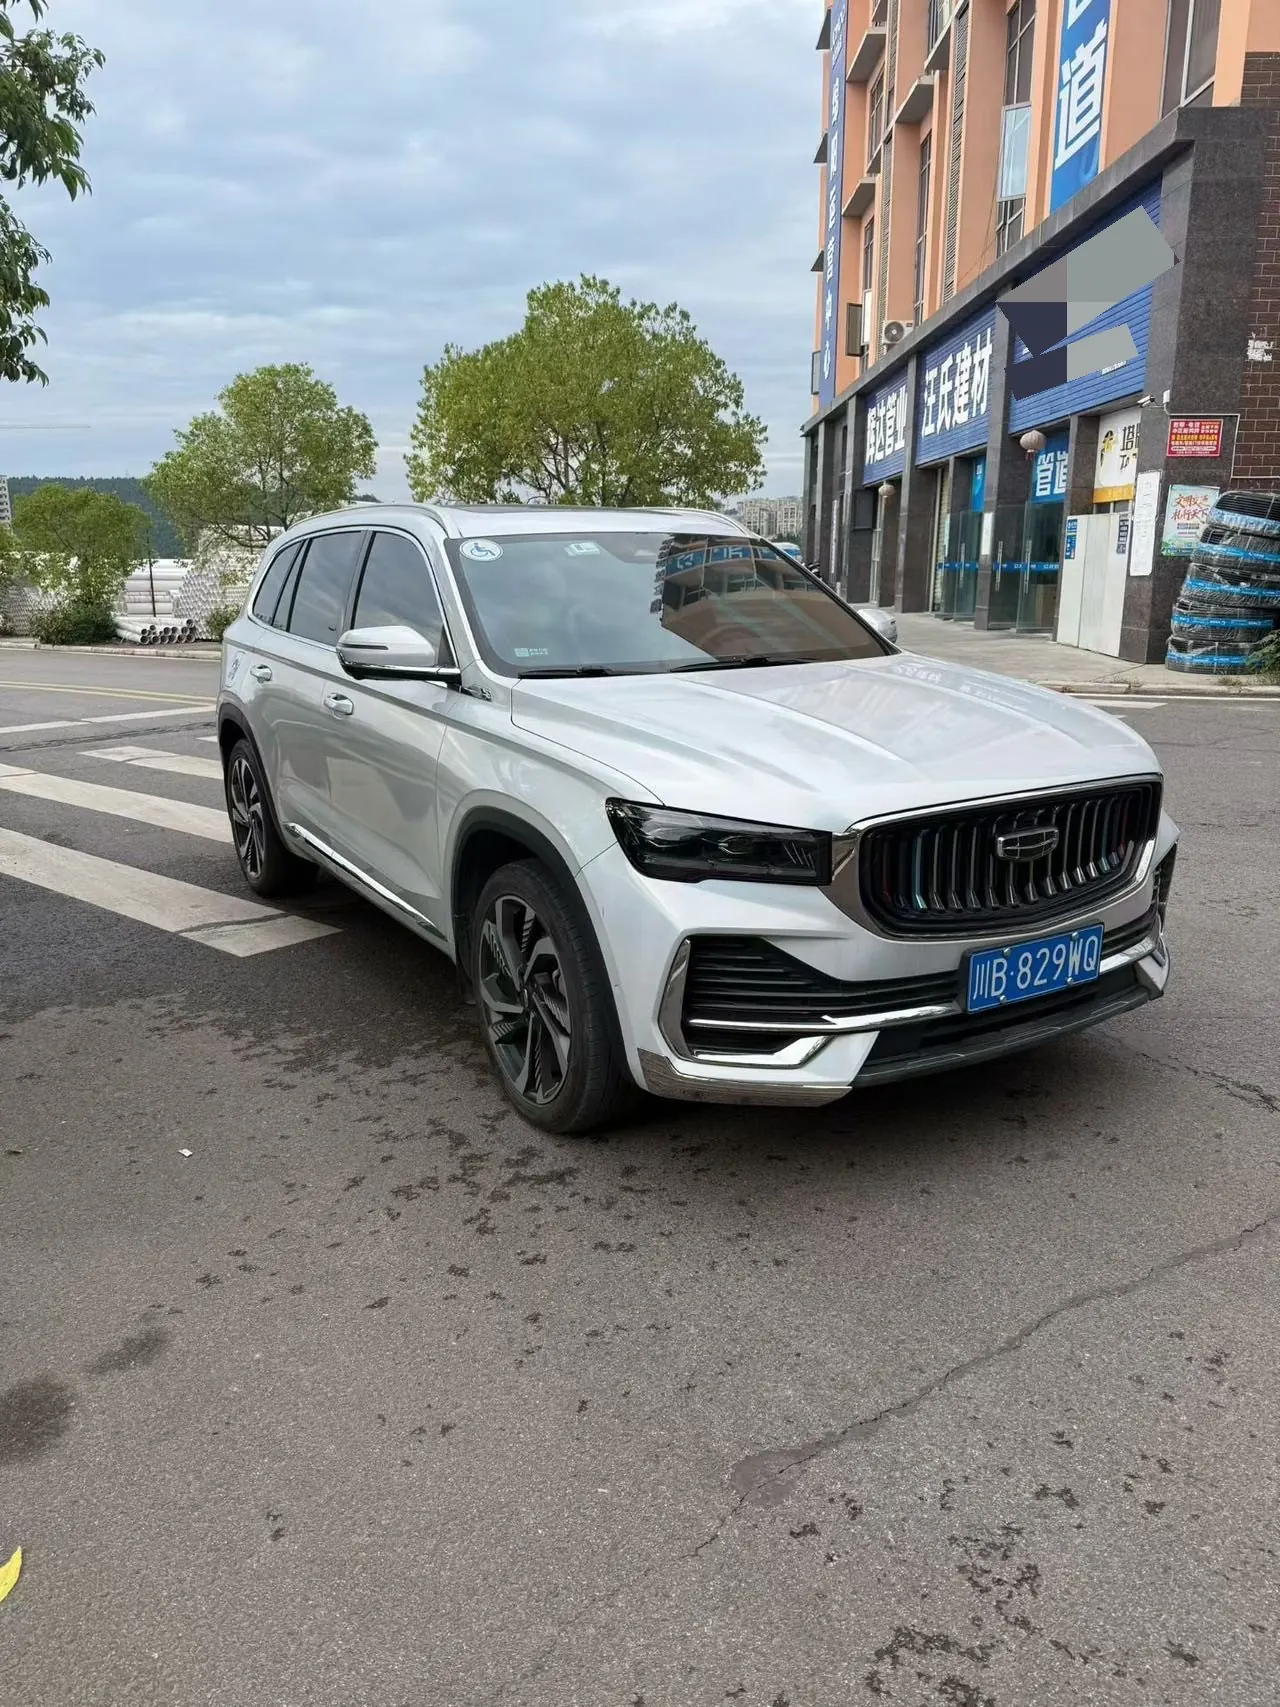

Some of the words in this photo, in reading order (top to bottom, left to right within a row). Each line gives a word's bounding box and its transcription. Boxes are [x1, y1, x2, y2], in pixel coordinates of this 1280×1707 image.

[1054, 0, 1108, 170] 道
[921, 327, 993, 438] 汪氏建材
[973, 935, 1099, 1000] 川B·829WQ
